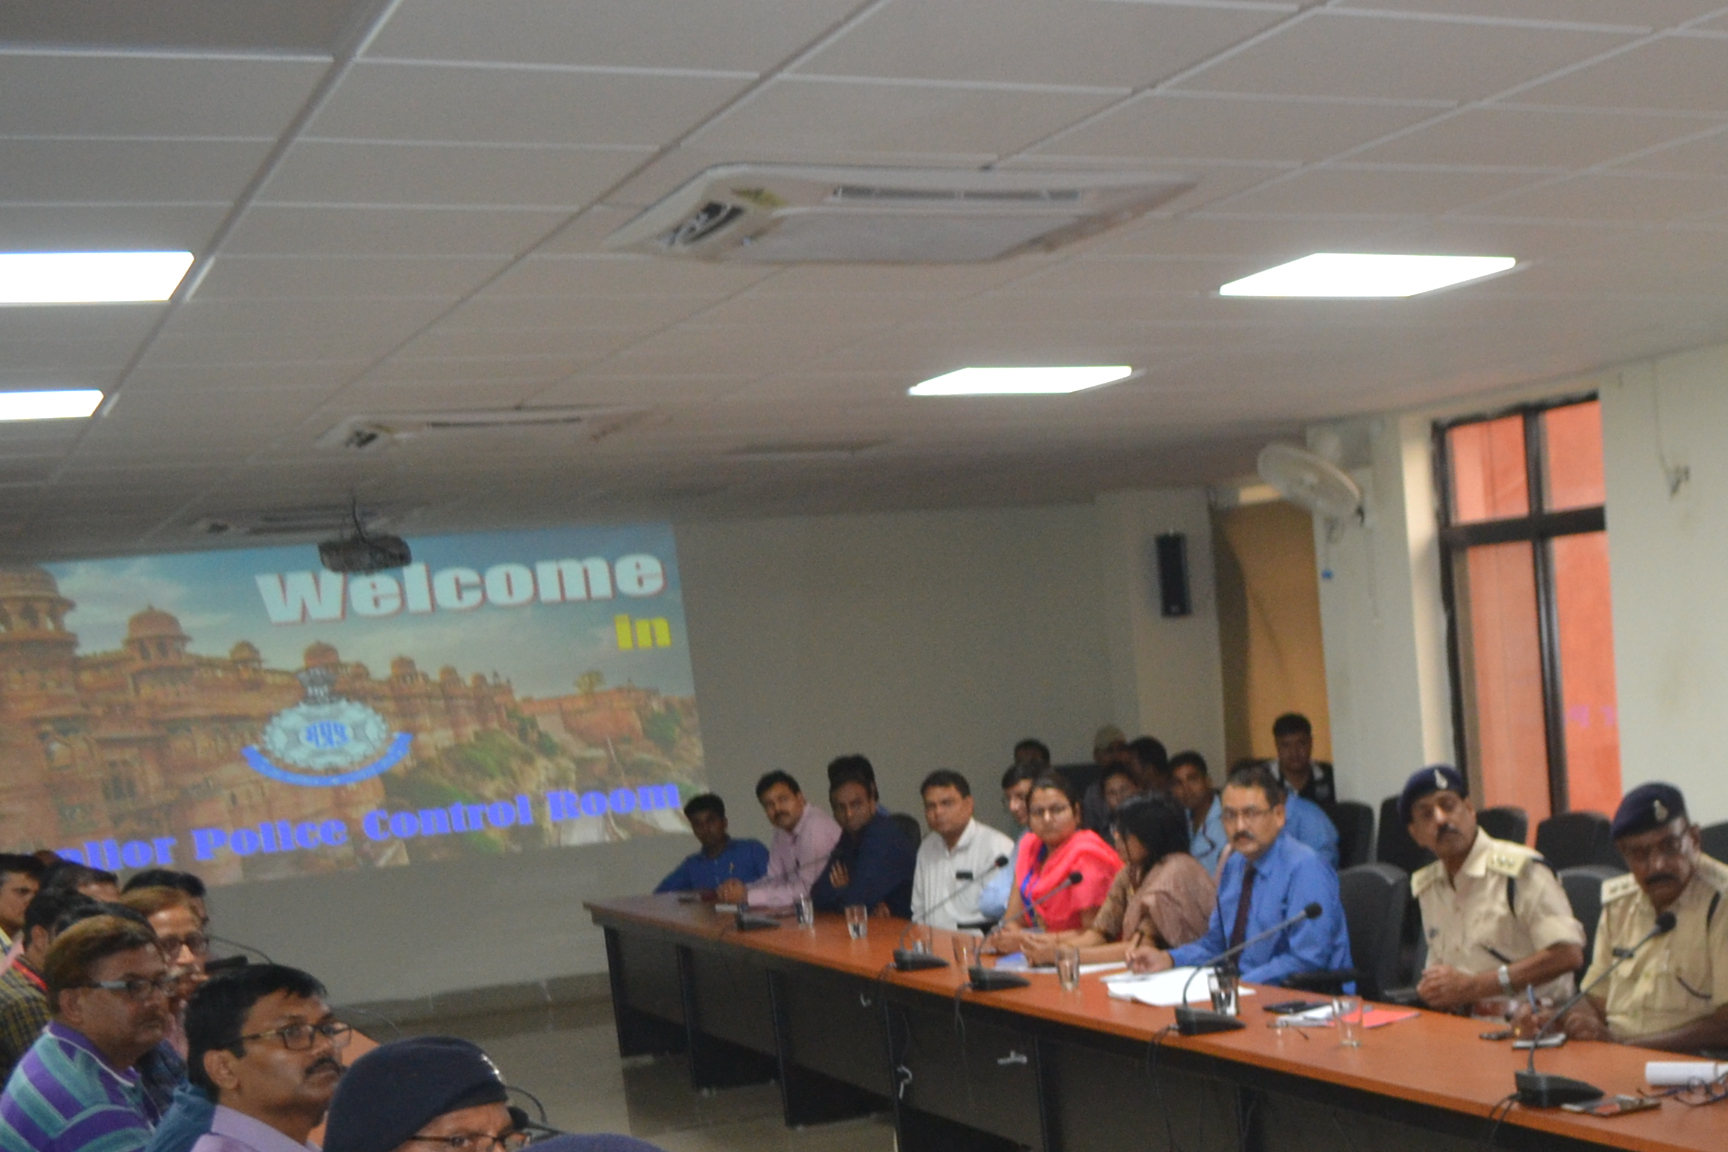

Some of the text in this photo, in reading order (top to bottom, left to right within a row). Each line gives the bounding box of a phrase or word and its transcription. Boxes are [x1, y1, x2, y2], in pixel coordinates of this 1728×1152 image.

[255, 554, 664, 624] Welcome
[191, 819, 348, 861] Police
[362, 794, 534, 841] Control
[546, 783, 681, 821] Room
